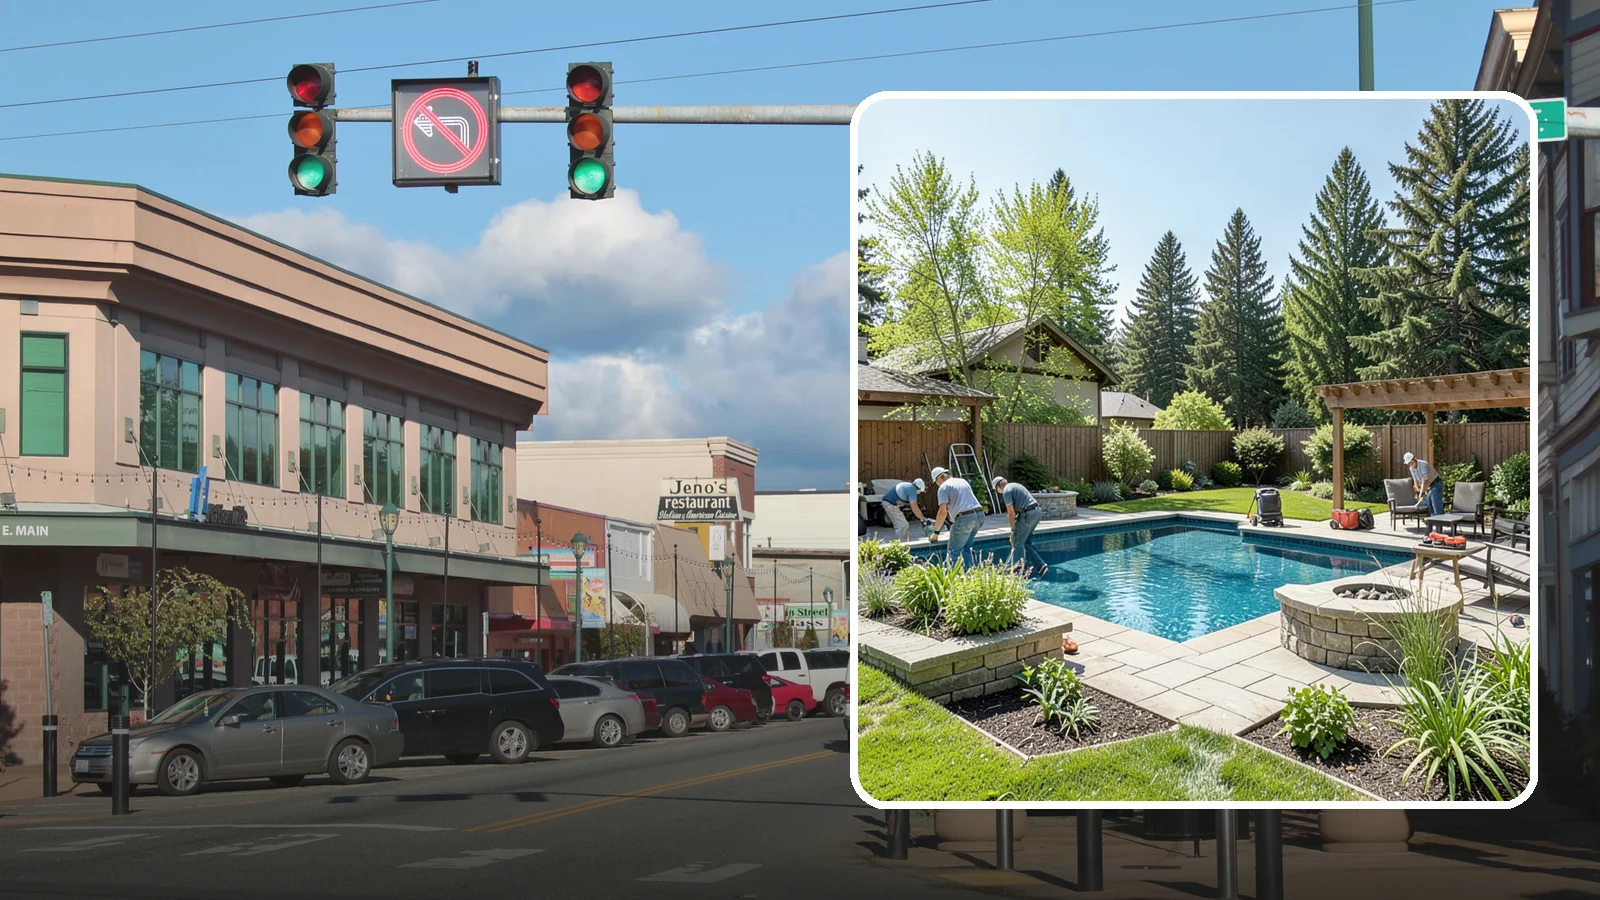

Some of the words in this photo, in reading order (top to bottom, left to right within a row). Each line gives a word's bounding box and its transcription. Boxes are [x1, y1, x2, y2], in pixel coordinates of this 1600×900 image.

[670, 480, 727, 494] Jeno's
[665, 496, 731, 509] restaurant
[659, 510, 681, 519] Italian
[686, 510, 714, 519] American
[715, 510, 737, 519] Cuisine
[2, 525, 13, 536] E.
[15, 525, 49, 536] MAIN
[785, 607, 795, 617] in
[797, 607, 828, 617] Street
